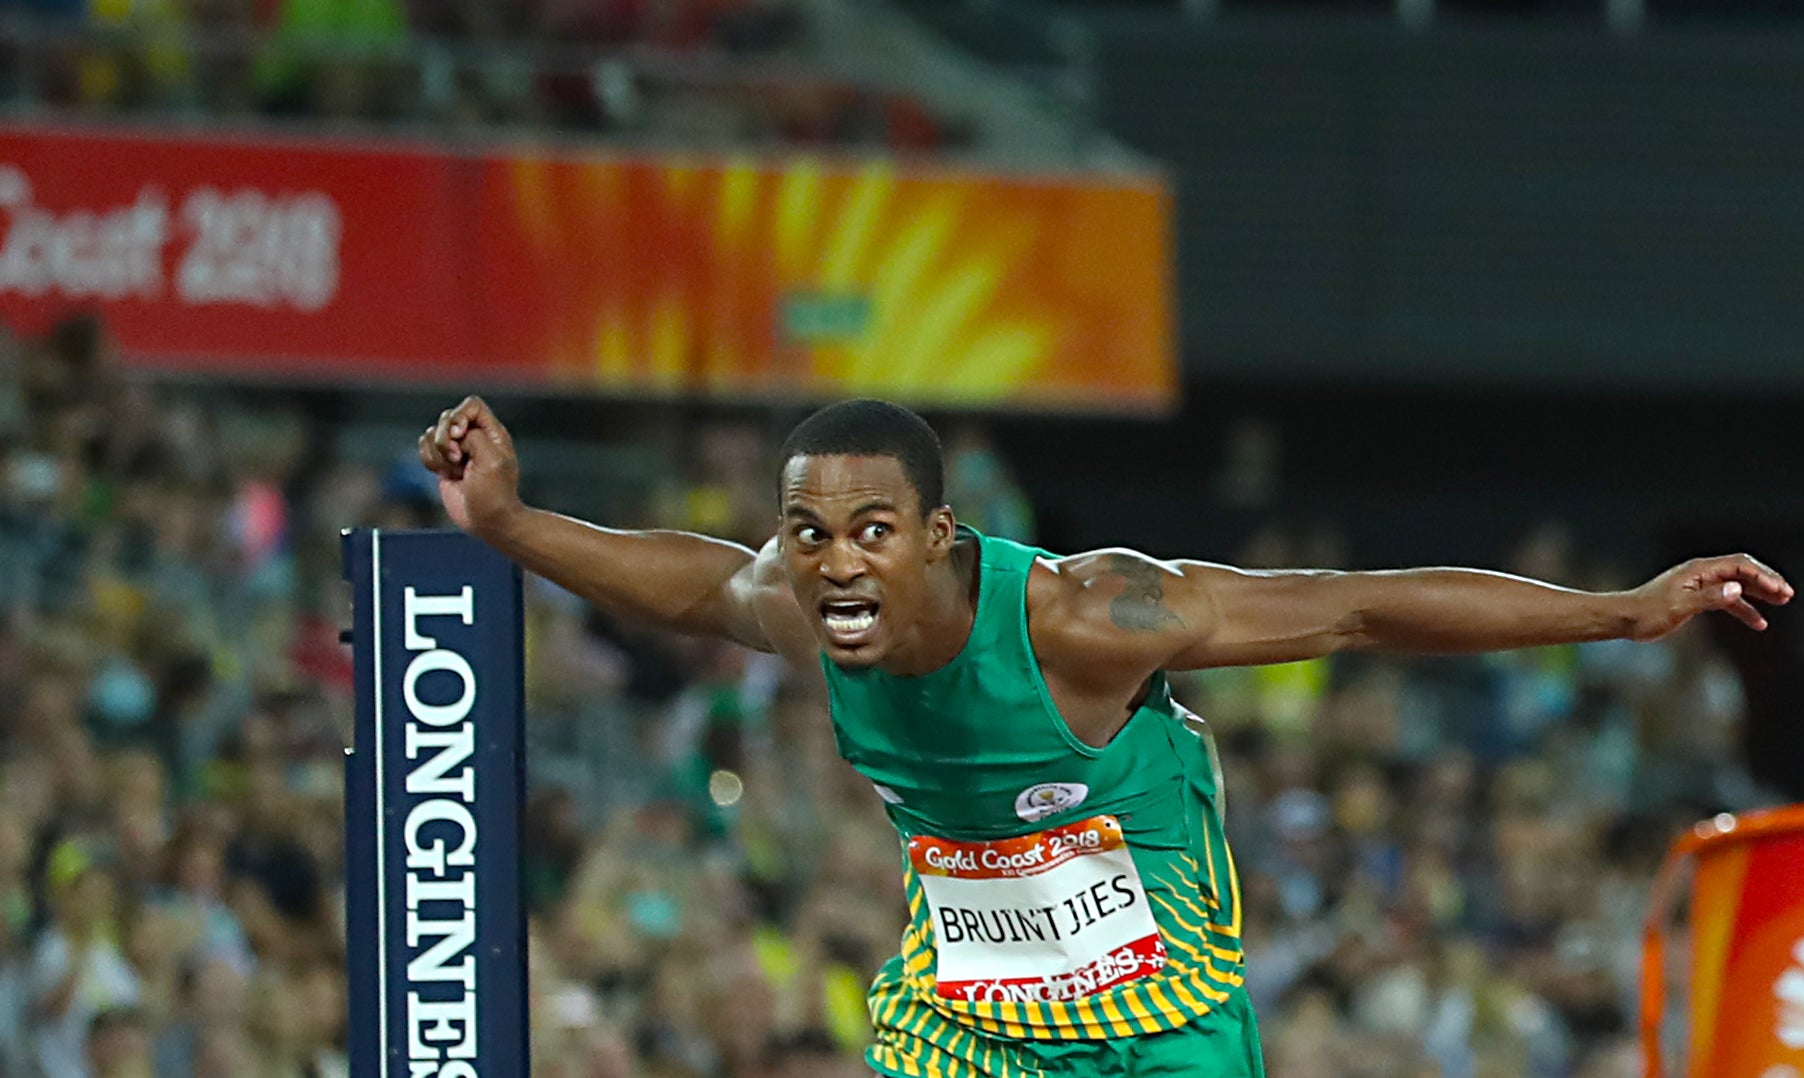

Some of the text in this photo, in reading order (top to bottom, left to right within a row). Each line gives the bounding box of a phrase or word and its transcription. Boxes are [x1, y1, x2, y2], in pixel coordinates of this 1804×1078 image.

[925, 847, 978, 873] Gold
[981, 843, 1045, 870] Coast
[1049, 829, 1100, 857] 2018
[938, 874, 1136, 944] BRUINTJIES
